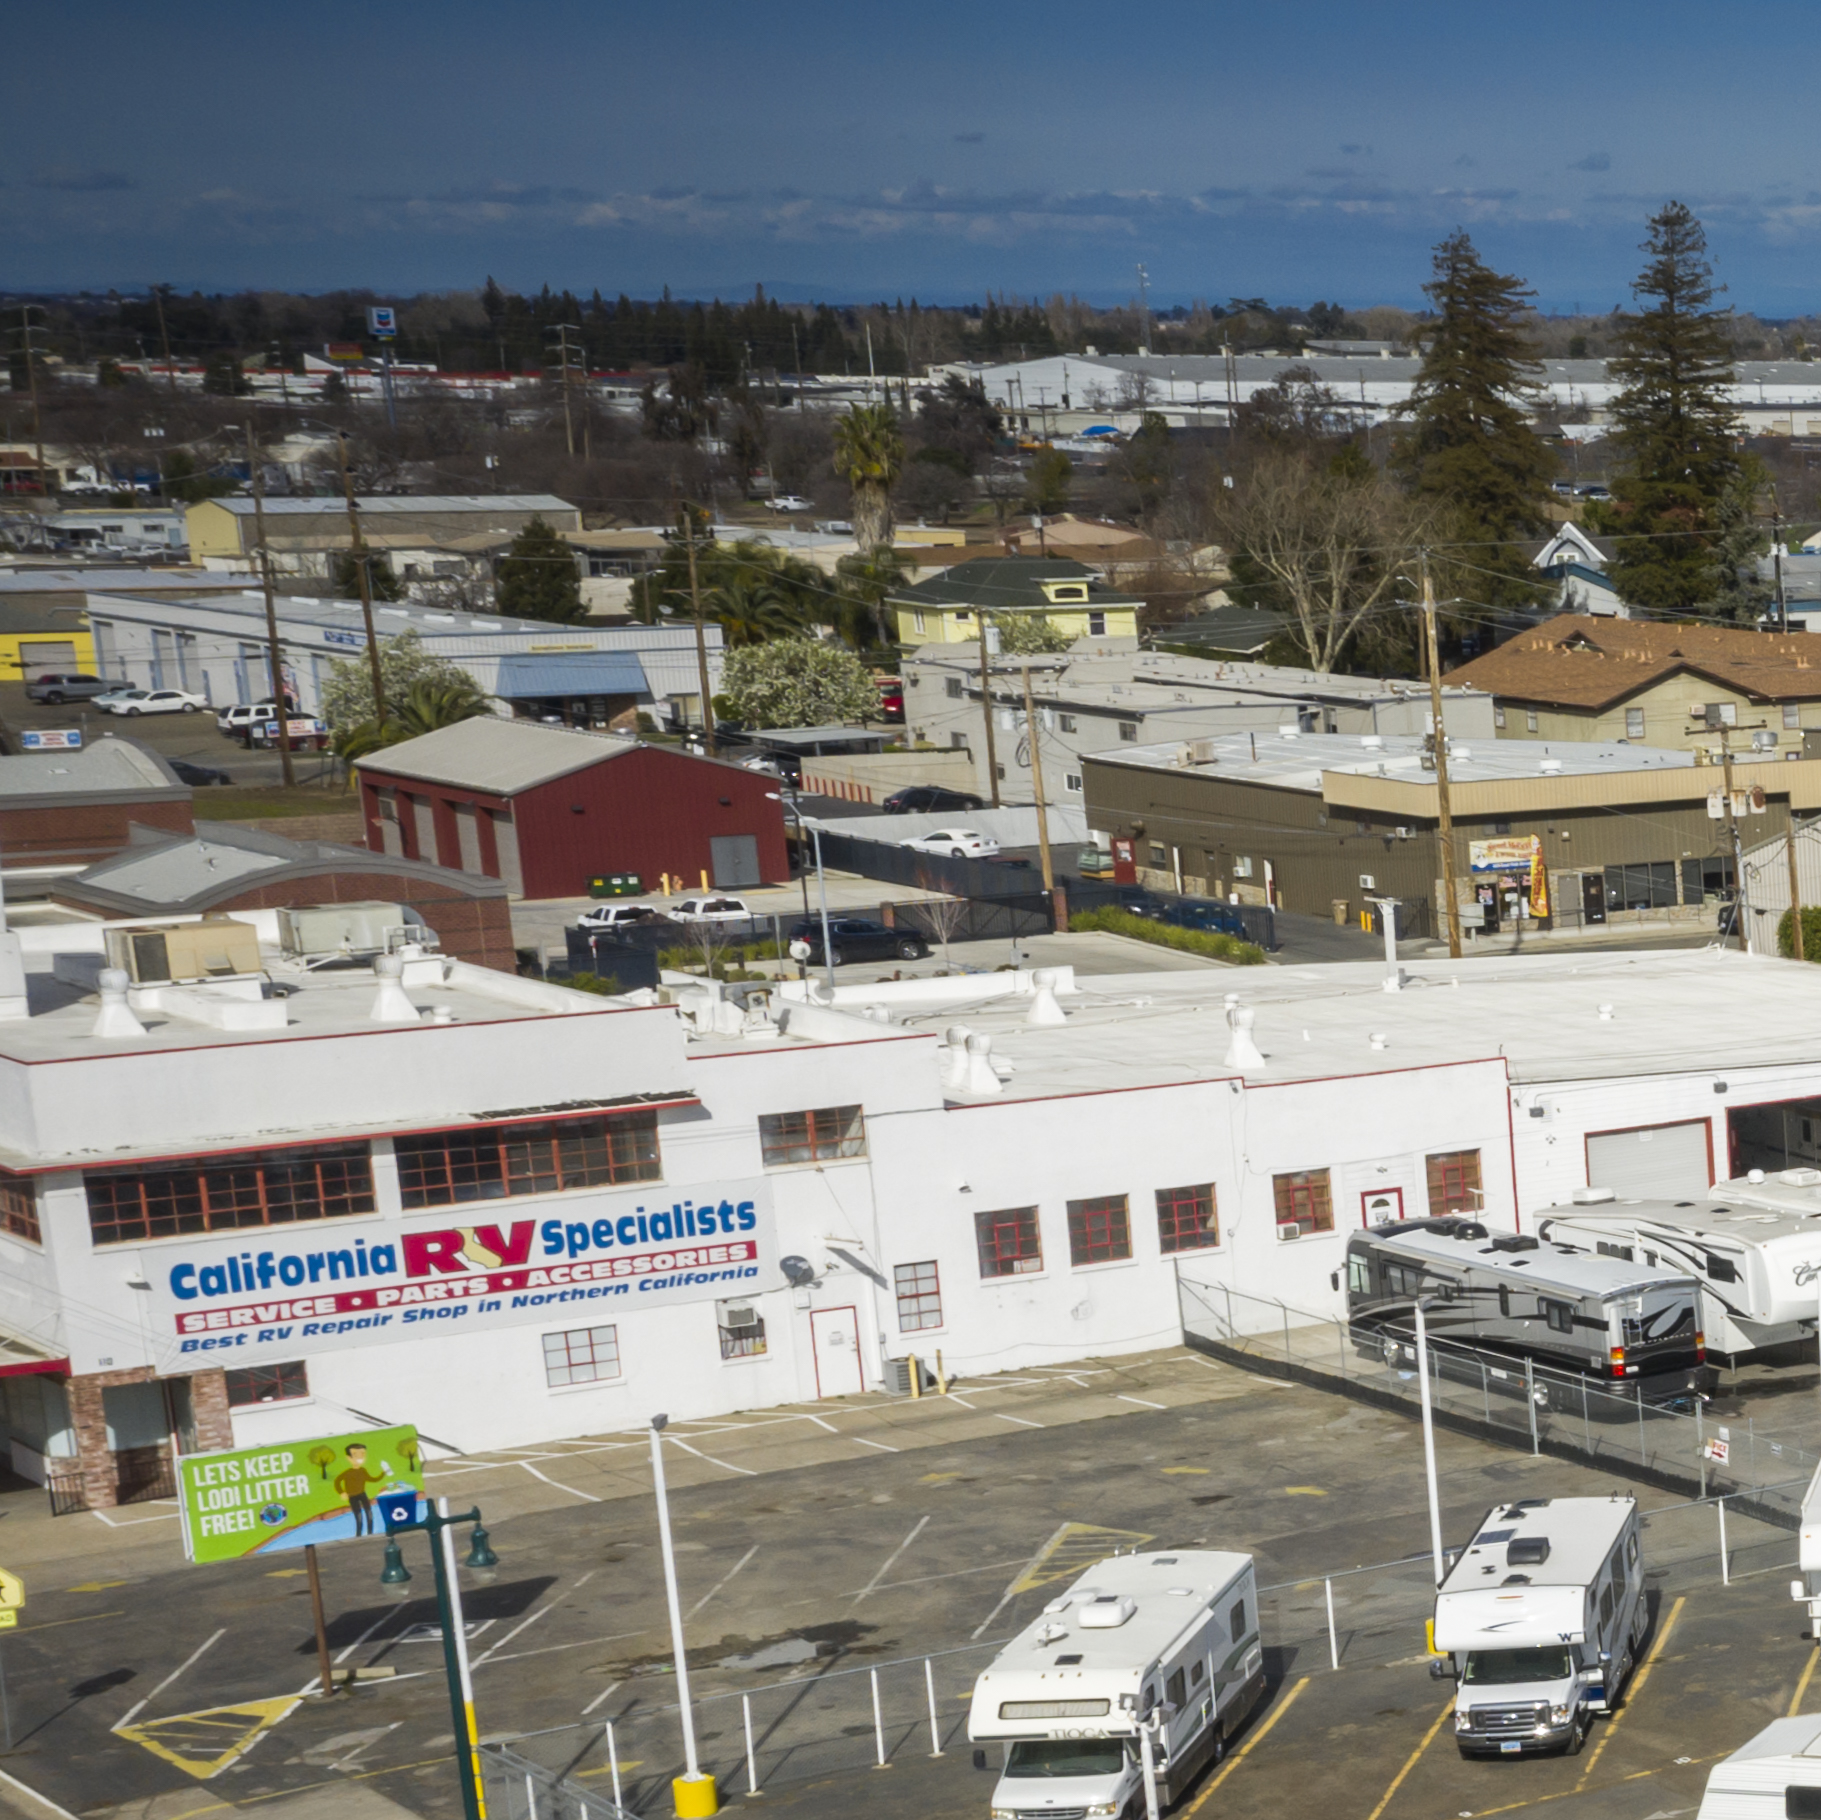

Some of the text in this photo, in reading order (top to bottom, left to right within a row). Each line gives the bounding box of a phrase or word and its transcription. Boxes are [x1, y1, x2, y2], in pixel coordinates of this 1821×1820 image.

[169, 1199, 757, 1300] California RV Specialists
[182, 1243, 749, 1332] SERVICE PARTS ACCESSORIES
[180, 1266, 759, 1353] Best RV Repair Shop in Northern California
[193, 1451, 294, 1487] LETS KEEP
[197, 1474, 311, 1513] LODI LITTER
[200, 1508, 256, 1537] FREE!
[1050, 1728, 1111, 1740] TIOGA
